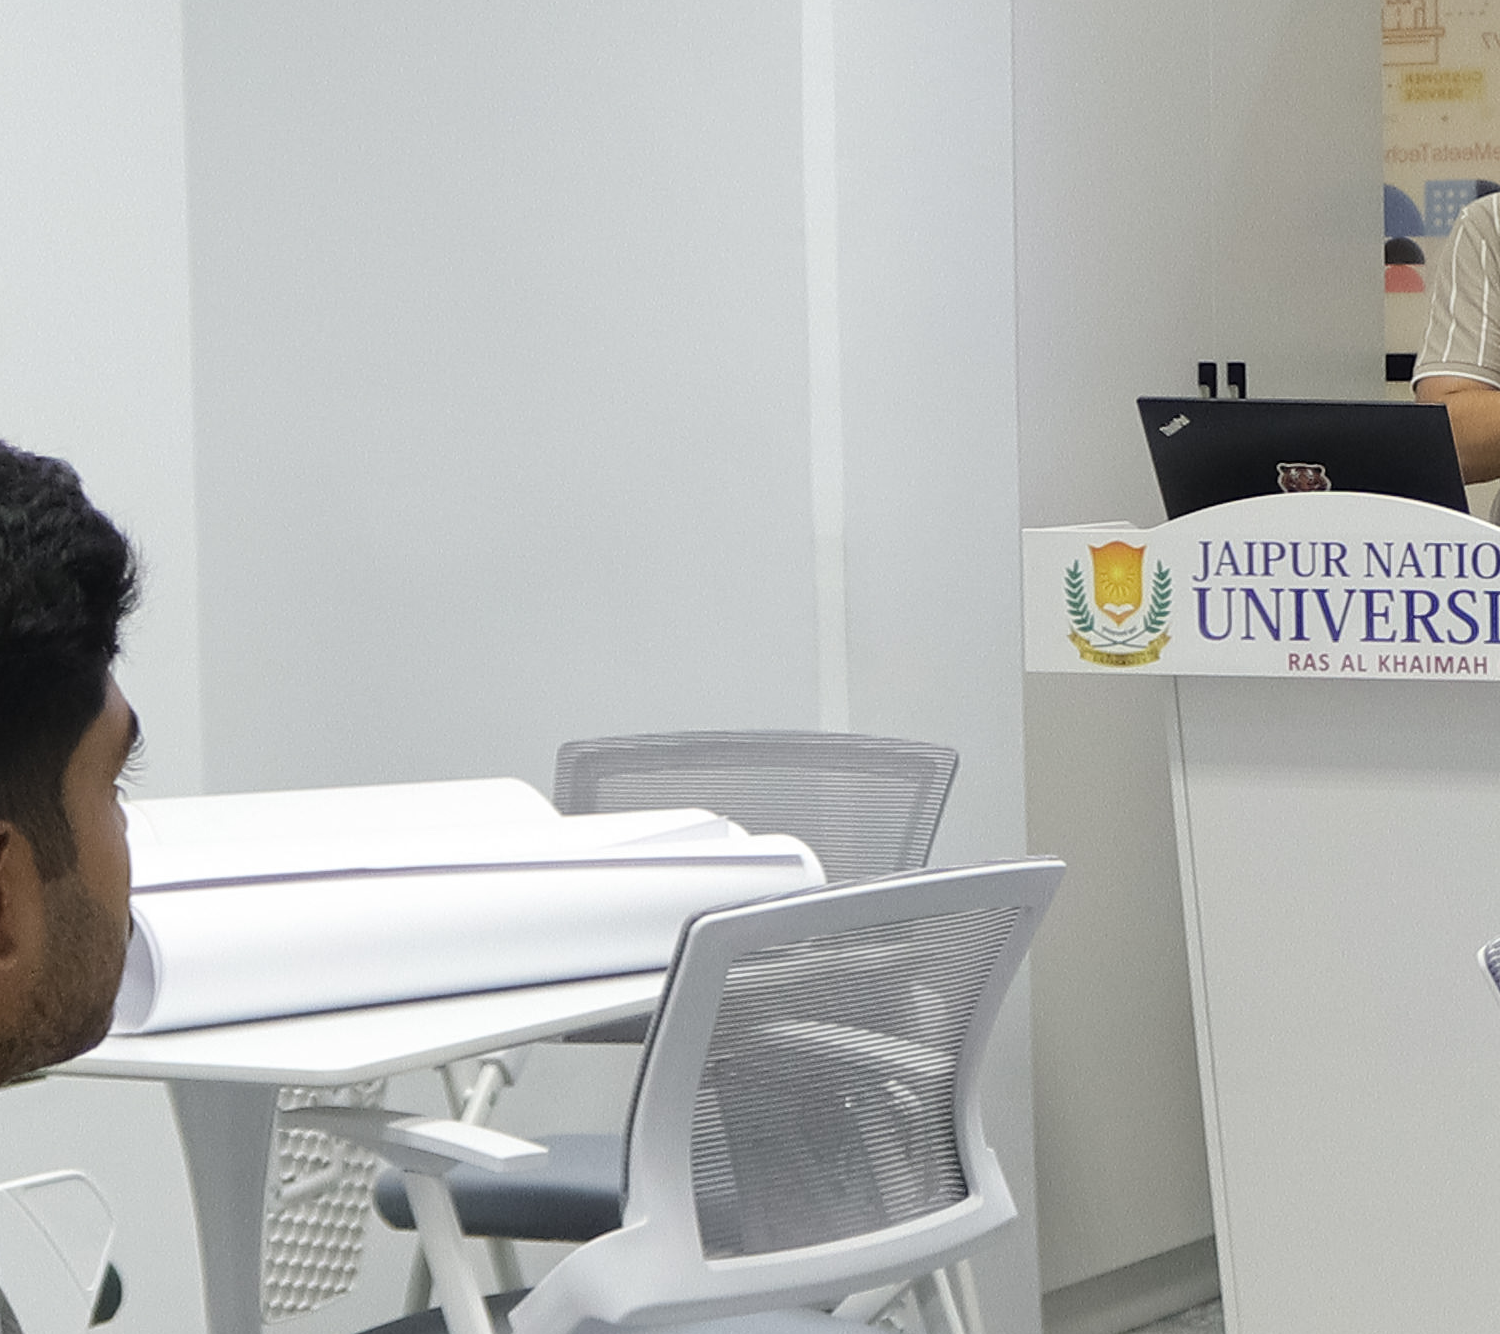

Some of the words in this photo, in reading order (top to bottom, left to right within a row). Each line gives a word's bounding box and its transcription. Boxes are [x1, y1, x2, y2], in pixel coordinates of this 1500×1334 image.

[1192, 540, 1351, 583] JAIPUR
[1288, 653, 1330, 672] RAS
[1340, 654, 1367, 673] AL
[1378, 655, 1488, 674] KHAIMAH
